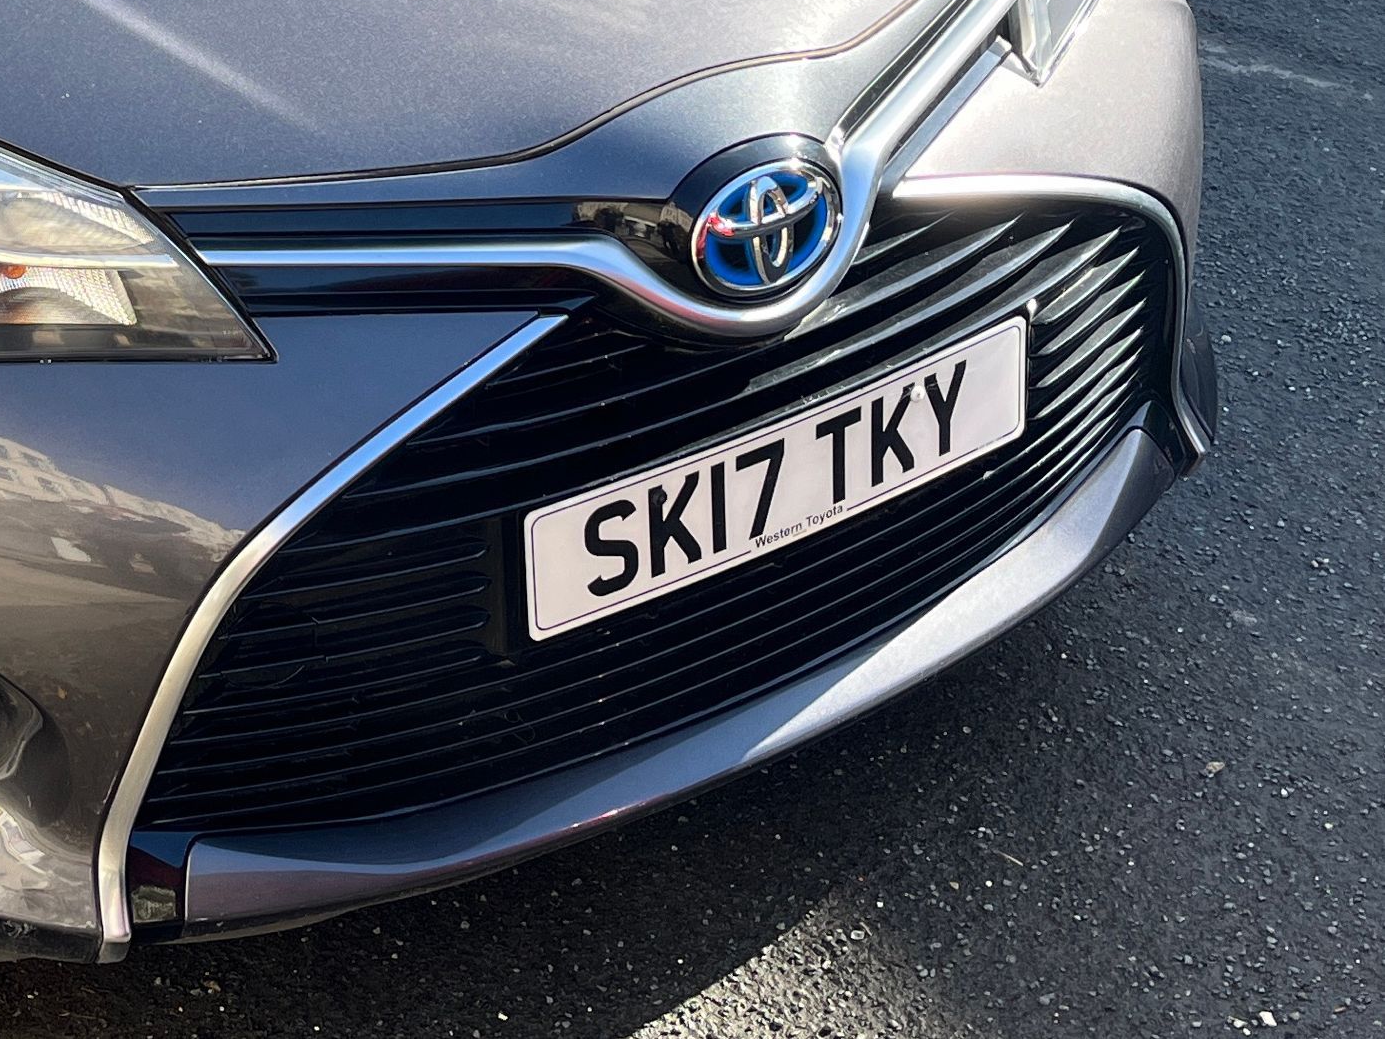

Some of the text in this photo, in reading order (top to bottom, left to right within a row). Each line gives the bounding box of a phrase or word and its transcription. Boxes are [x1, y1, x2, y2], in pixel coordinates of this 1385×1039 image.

[583, 359, 968, 597] SK17 TKY
[755, 504, 844, 548] Western Toyota
